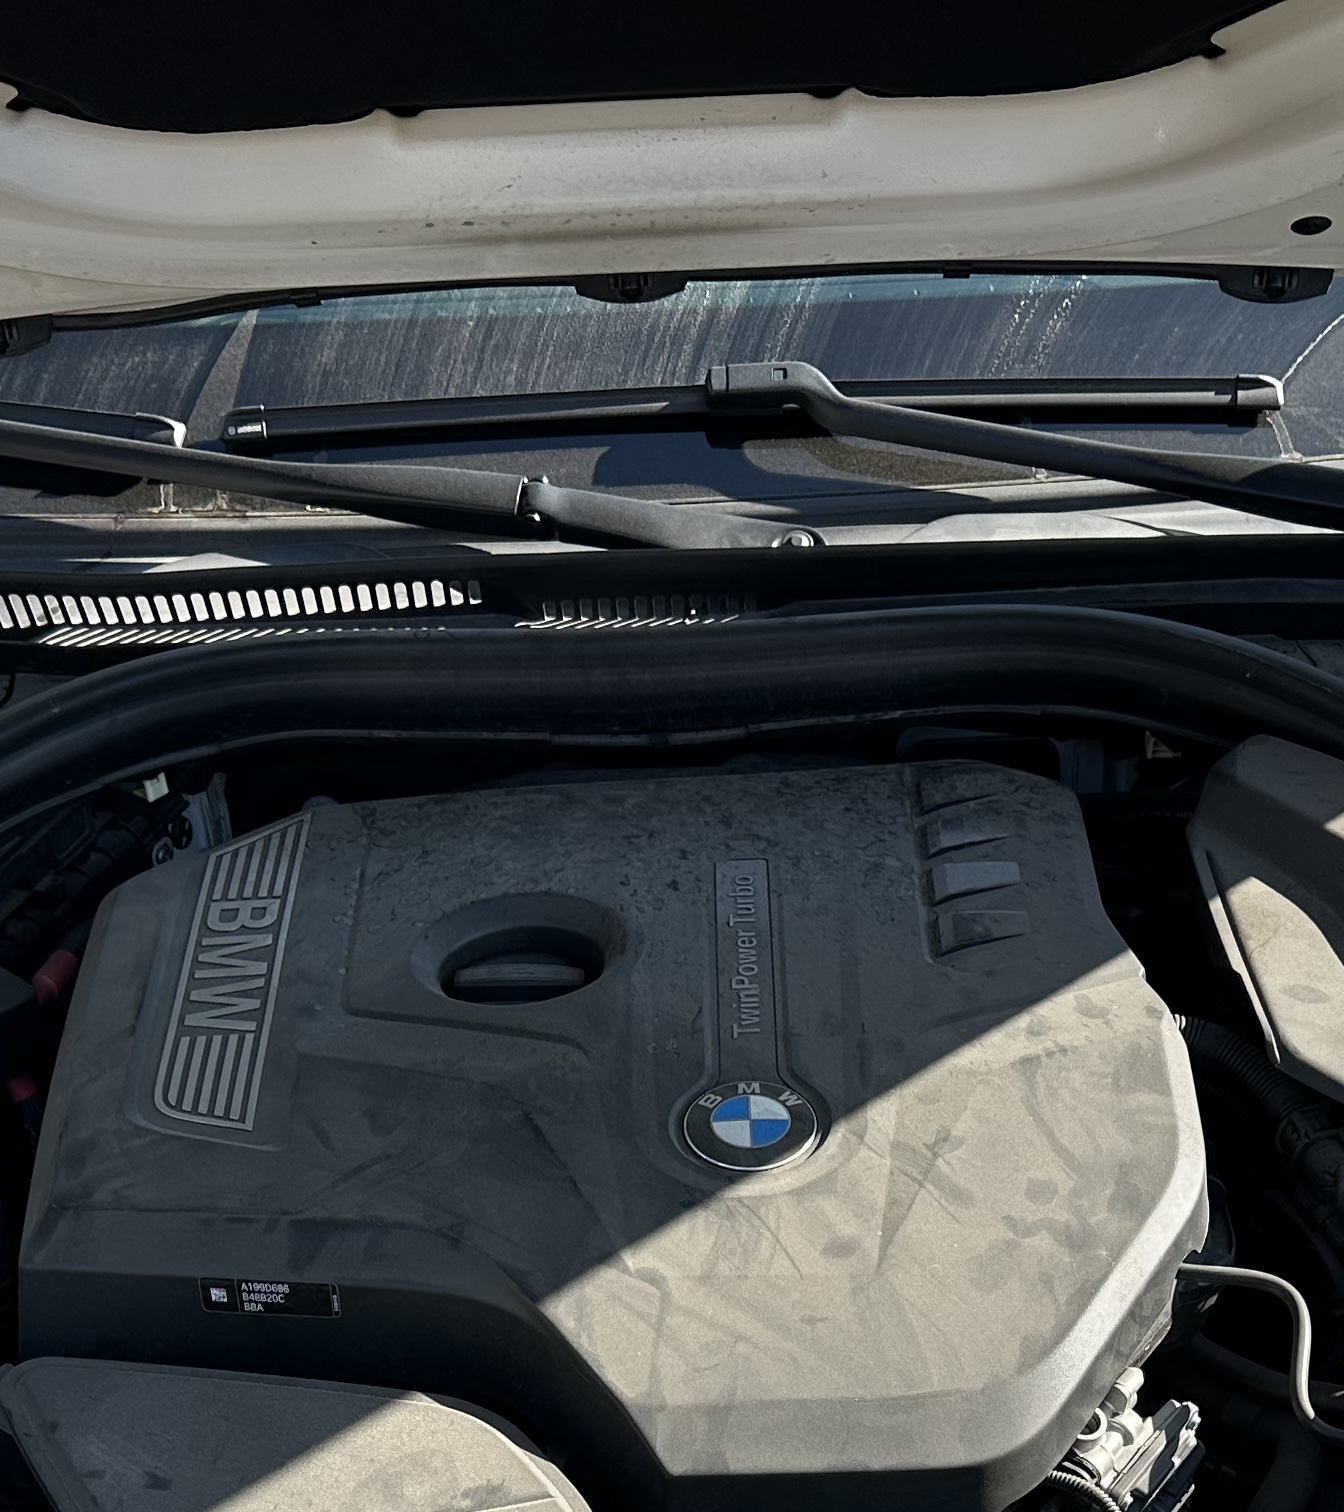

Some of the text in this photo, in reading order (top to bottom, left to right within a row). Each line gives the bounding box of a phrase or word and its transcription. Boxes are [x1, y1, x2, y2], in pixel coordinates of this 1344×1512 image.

[184, 899, 281, 1031] BMW
[728, 875, 761, 1039] TwinPower Turbo
[698, 1083, 803, 1108] BMW
